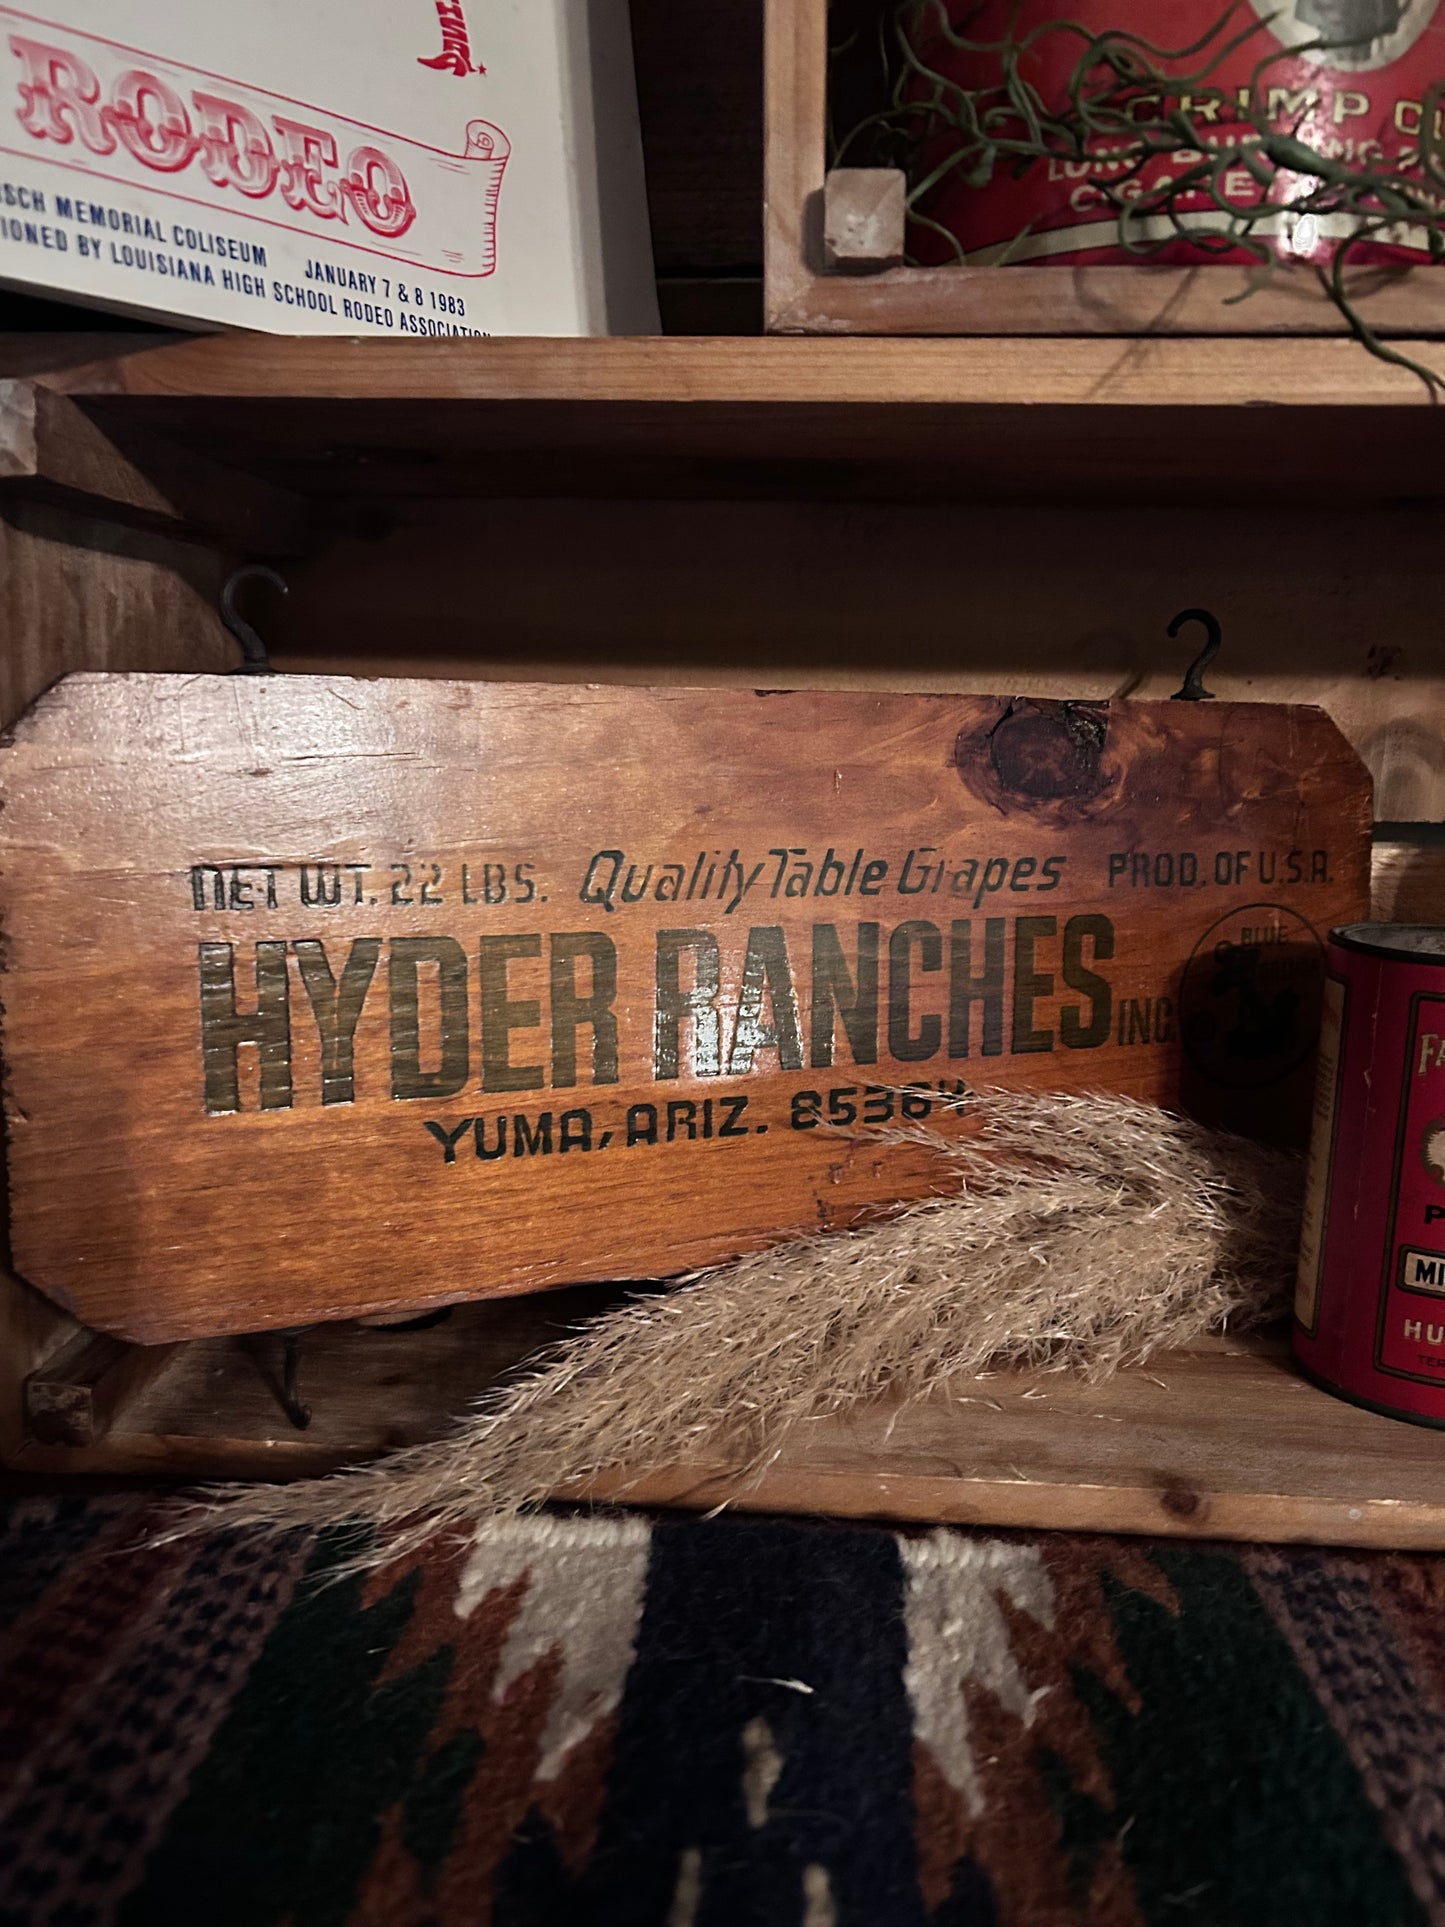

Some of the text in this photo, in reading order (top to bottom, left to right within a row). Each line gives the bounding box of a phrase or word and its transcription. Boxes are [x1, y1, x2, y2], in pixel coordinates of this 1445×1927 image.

[8, 34, 417, 238] RODEO
[1126, 86, 1370, 125] CRIMP
[0, 182, 466, 316] SCH MEMORIAL COLISEUM JANUARY 7 & 8 1983
[77, 233, 101, 259] BY
[111, 242, 216, 286] LOUISIANA
[222, 268, 267, 298] HIGH
[273, 280, 338, 316] SCHOOL
[343, 298, 394, 327] RODEO
[400, 311, 491, 337] ASSOCIAT
[190, 862, 549, 911] NET WT. 22 LBS.
[579, 846, 1067, 915] Quality Table Grapes
[1108, 851, 1206, 888] PROD.
[1213, 850, 1252, 886] OF
[1239, 926, 1290, 947] BLUE
[199, 931, 619, 1118] HYDER
[655, 913, 1116, 1081] RANCHES
[423, 1107, 614, 1165] YUMA,
[625, 1095, 769, 1148] ARIZ.
[1404, 1319, 1445, 1344] HU
